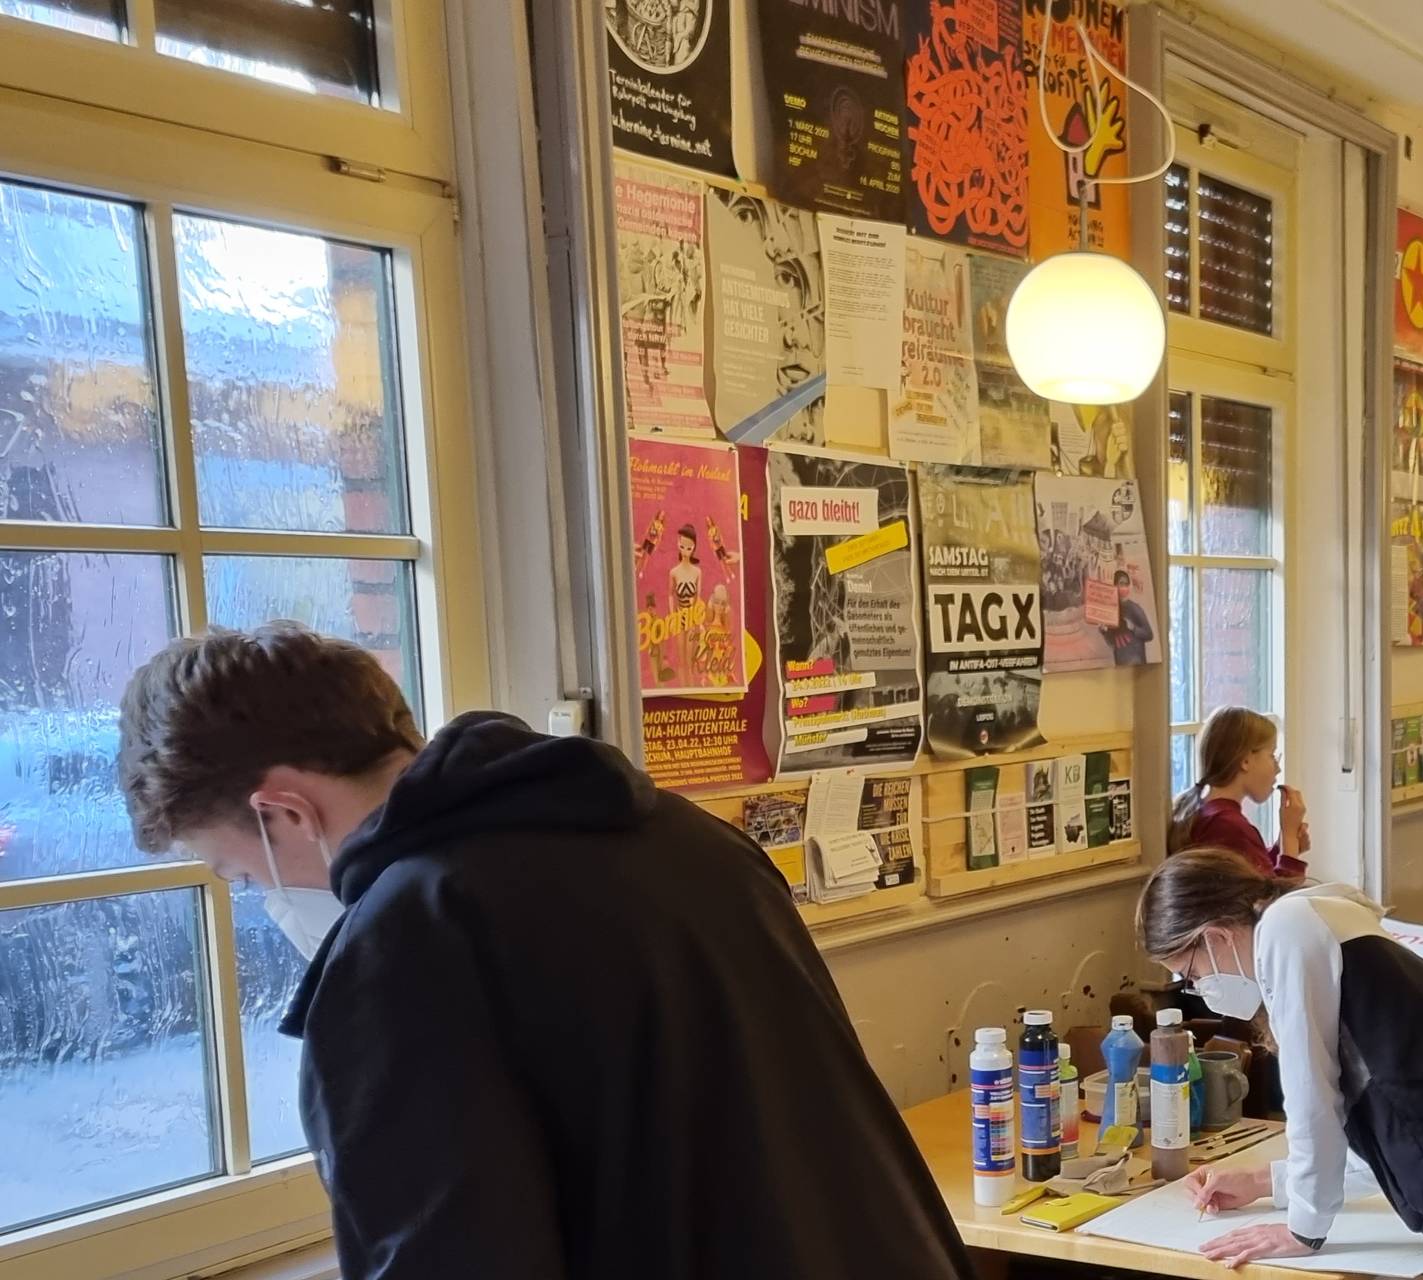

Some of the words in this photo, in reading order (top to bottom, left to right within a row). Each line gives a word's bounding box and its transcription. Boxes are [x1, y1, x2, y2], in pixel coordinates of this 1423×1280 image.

[626, 184, 697, 215] Hegemonie
[905, 288, 949, 317] Kultur
[902, 310, 957, 342] braucht
[901, 338, 966, 368] reiräume
[921, 365, 942, 388] 2.0
[788, 500, 818, 522] gazo
[821, 499, 861, 523] bleibt!
[928, 545, 989, 567] SAMSTAG
[934, 591, 1009, 644] TAG
[1012, 592, 1036, 641] X
[643, 707, 717, 726] MONSTRATION
[718, 706, 738, 721] ZUR
[643, 719, 749, 739] VIA-HAUPTZENTRALE
[723, 734, 738, 745] UHR
